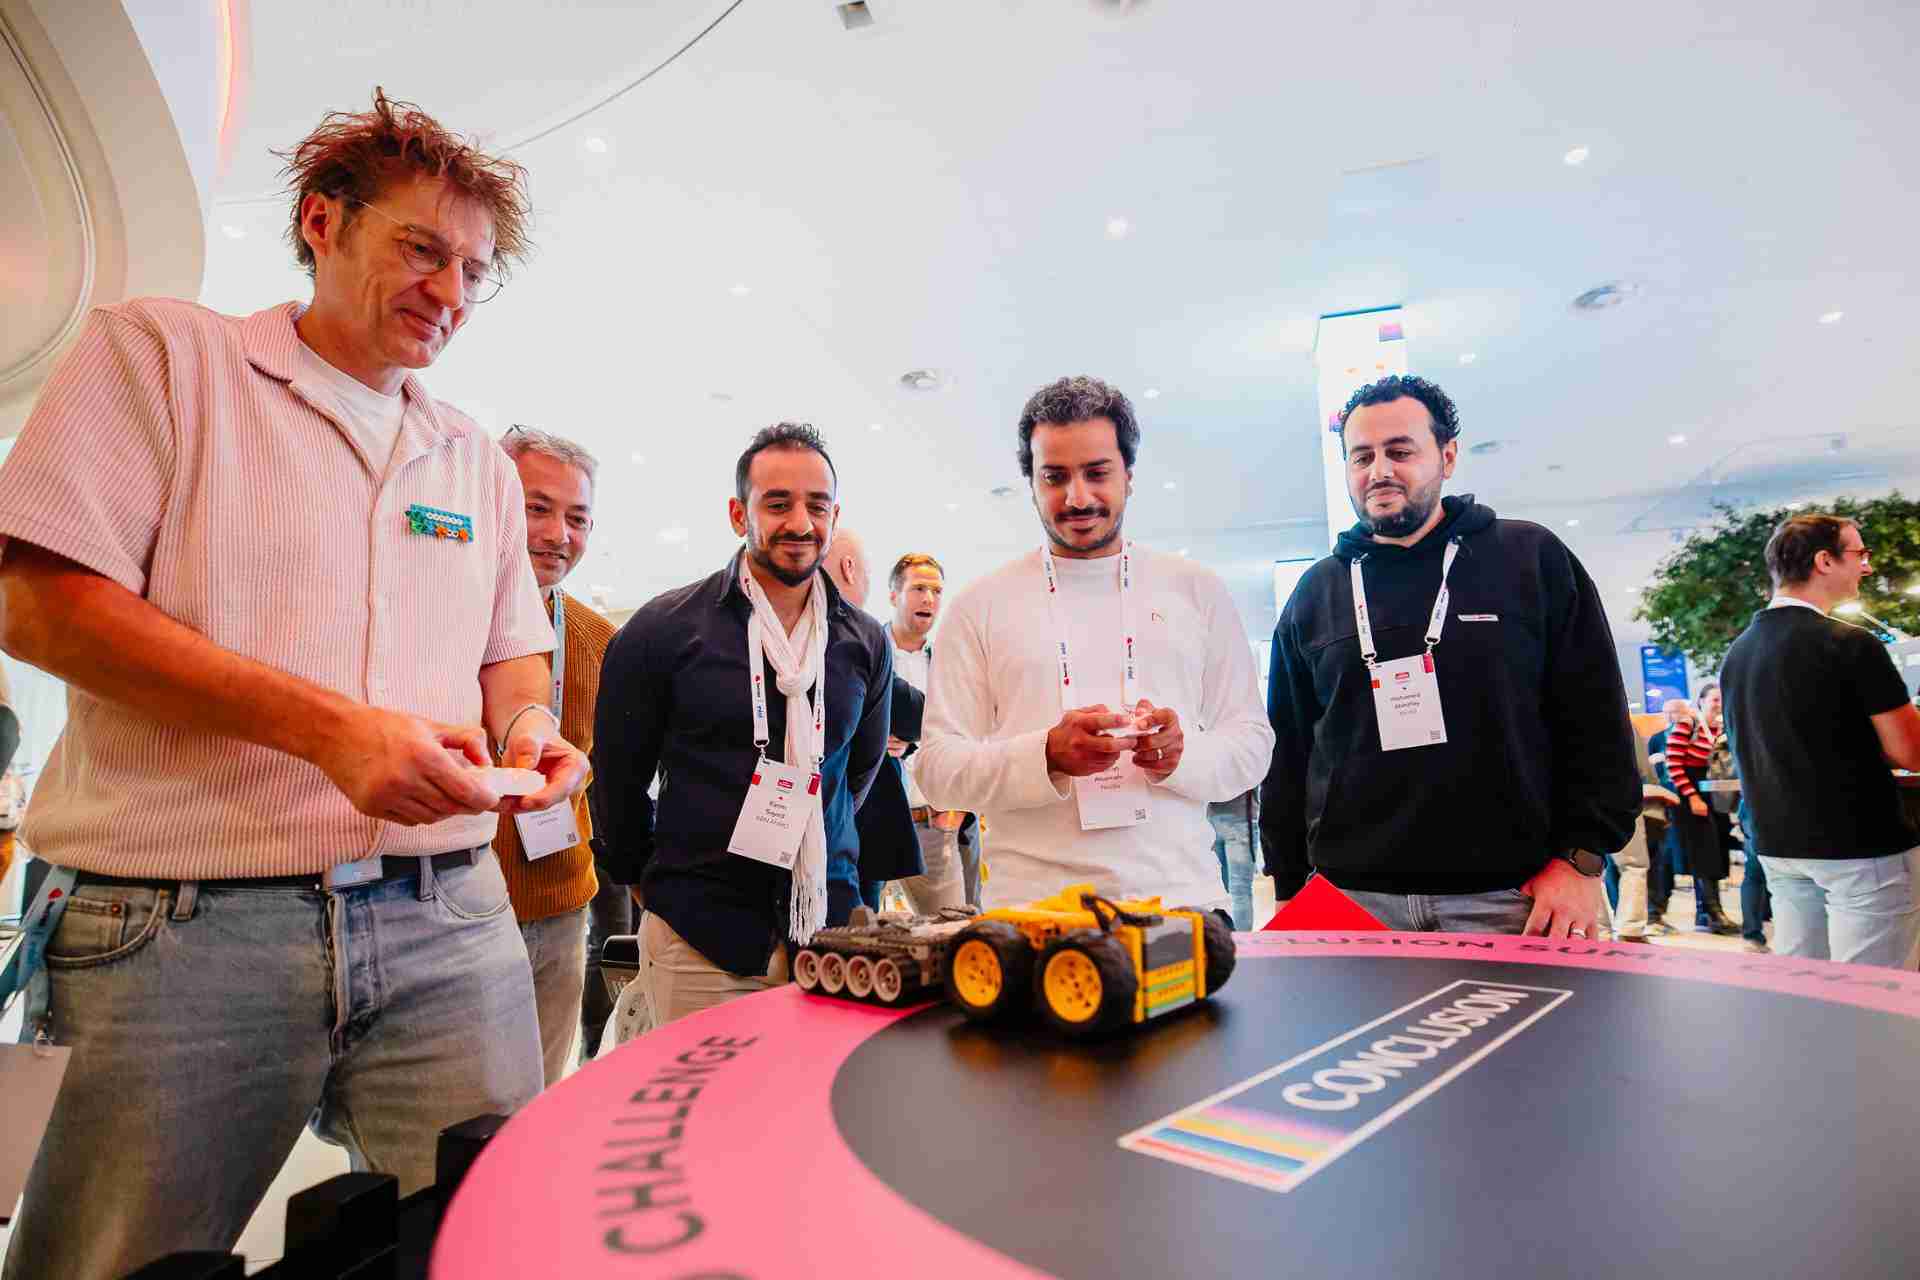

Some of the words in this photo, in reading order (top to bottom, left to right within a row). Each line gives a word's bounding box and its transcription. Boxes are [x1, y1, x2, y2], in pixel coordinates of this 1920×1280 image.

[1251, 937, 1494, 948] CLUSION
[1282, 988, 1530, 1111] CONCLUSION
[595, 1034, 760, 1256] CHALLENGE
